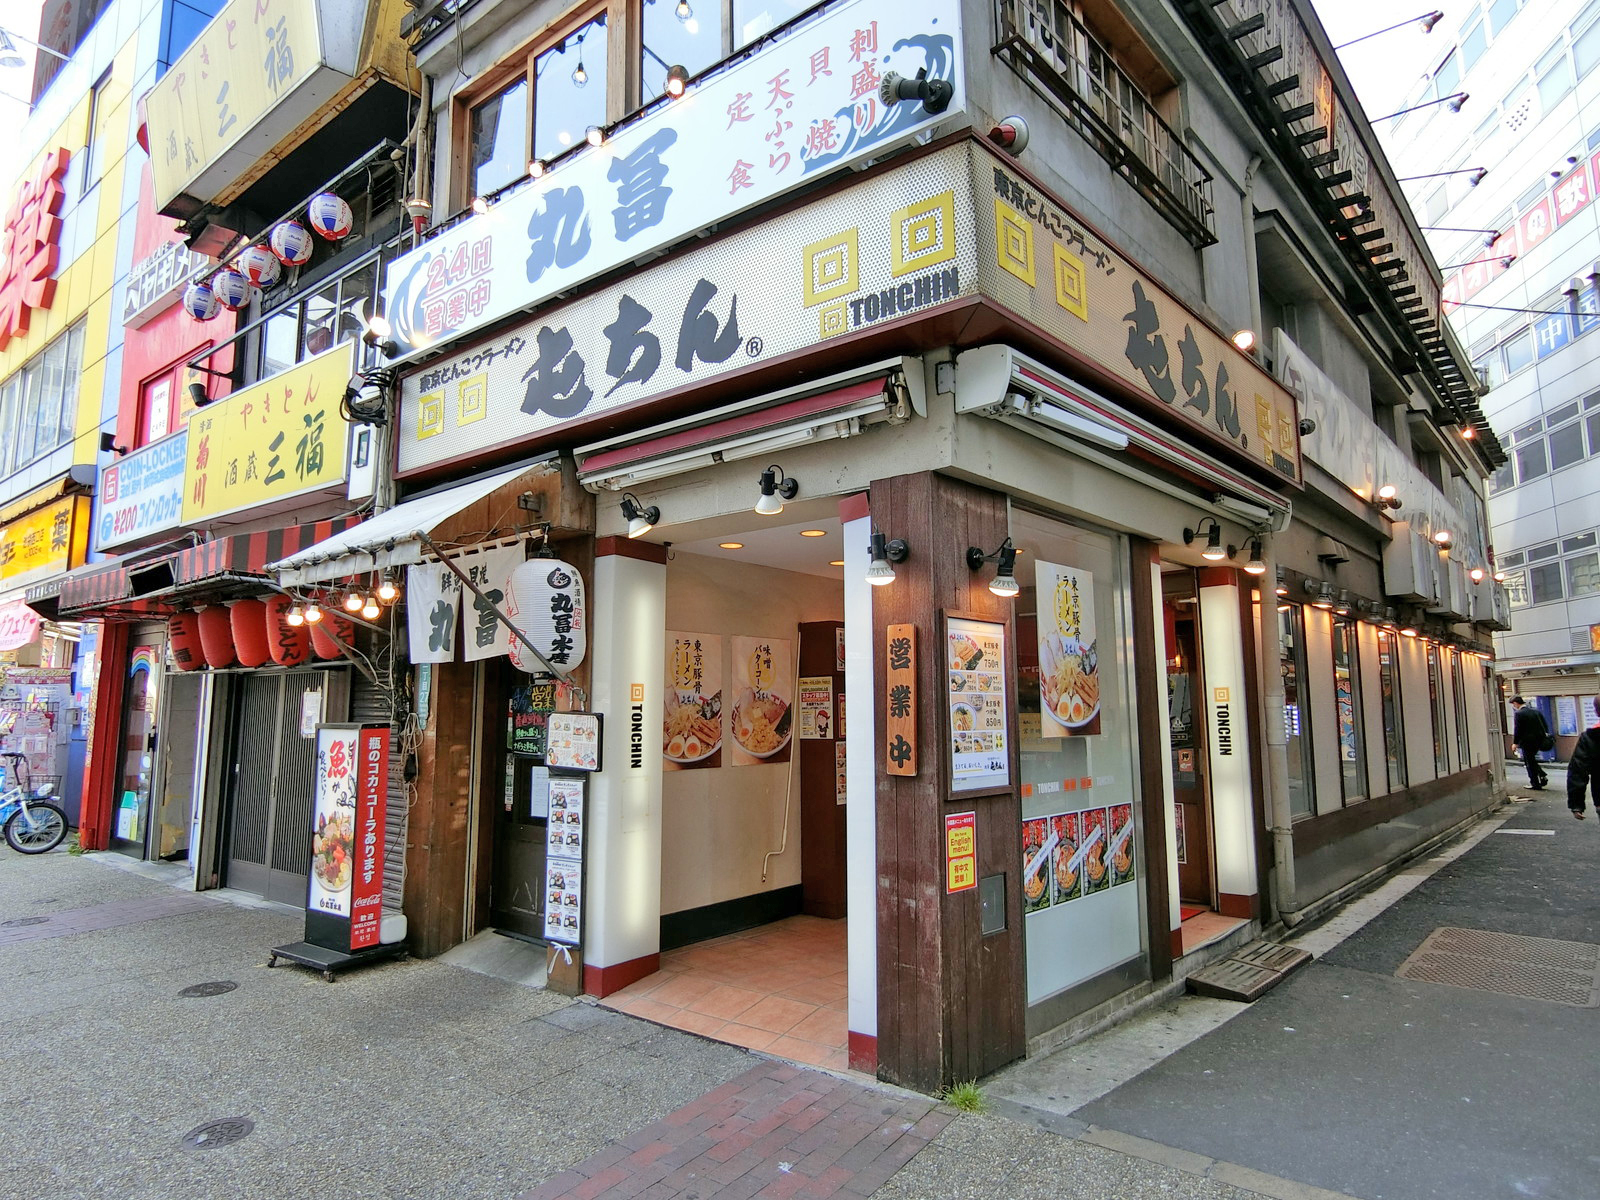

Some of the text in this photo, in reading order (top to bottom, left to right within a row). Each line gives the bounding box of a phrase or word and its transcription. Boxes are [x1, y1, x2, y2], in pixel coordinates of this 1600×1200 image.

[848, 21, 881, 132] 刺盛り
[726, 92, 755, 195] 定食
[764, 69, 795, 175] 天ぷら
[993, 166, 1116, 276] 東京とんこつラーメン
[427, 236, 493, 296] 24H
[424, 279, 492, 338] 営業中
[850, 267, 959, 326] TONCHIN
[419, 337, 526, 393] 東京とんこつラーメン
[240, 374, 320, 430] やきとん
[120, 436, 187, 482] COIN-LOCKER
[1063, 575, 1072, 632] ラーメン
[1072, 576, 1081, 643] 東京豚骨
[683, 639, 692, 686] ラーメン
[693, 639, 703, 694] 東京豚骨
[754, 645, 762, 694] バターコーン
[762, 644, 771, 669] 味噌
[889, 637, 912, 769] 営業中
[1216, 704, 1232, 755] TONCHIN
[630, 704, 642, 769] TONCHIN
[363, 737, 382, 884] 瓶のコカ・コーラあります
[1038, 781, 1059, 794] TONCHIN
[951, 837, 971, 847] English
[953, 845, 970, 854] menu!
[954, 863, 969, 874] 有中文
[353, 920, 377, 929] WELCOME
